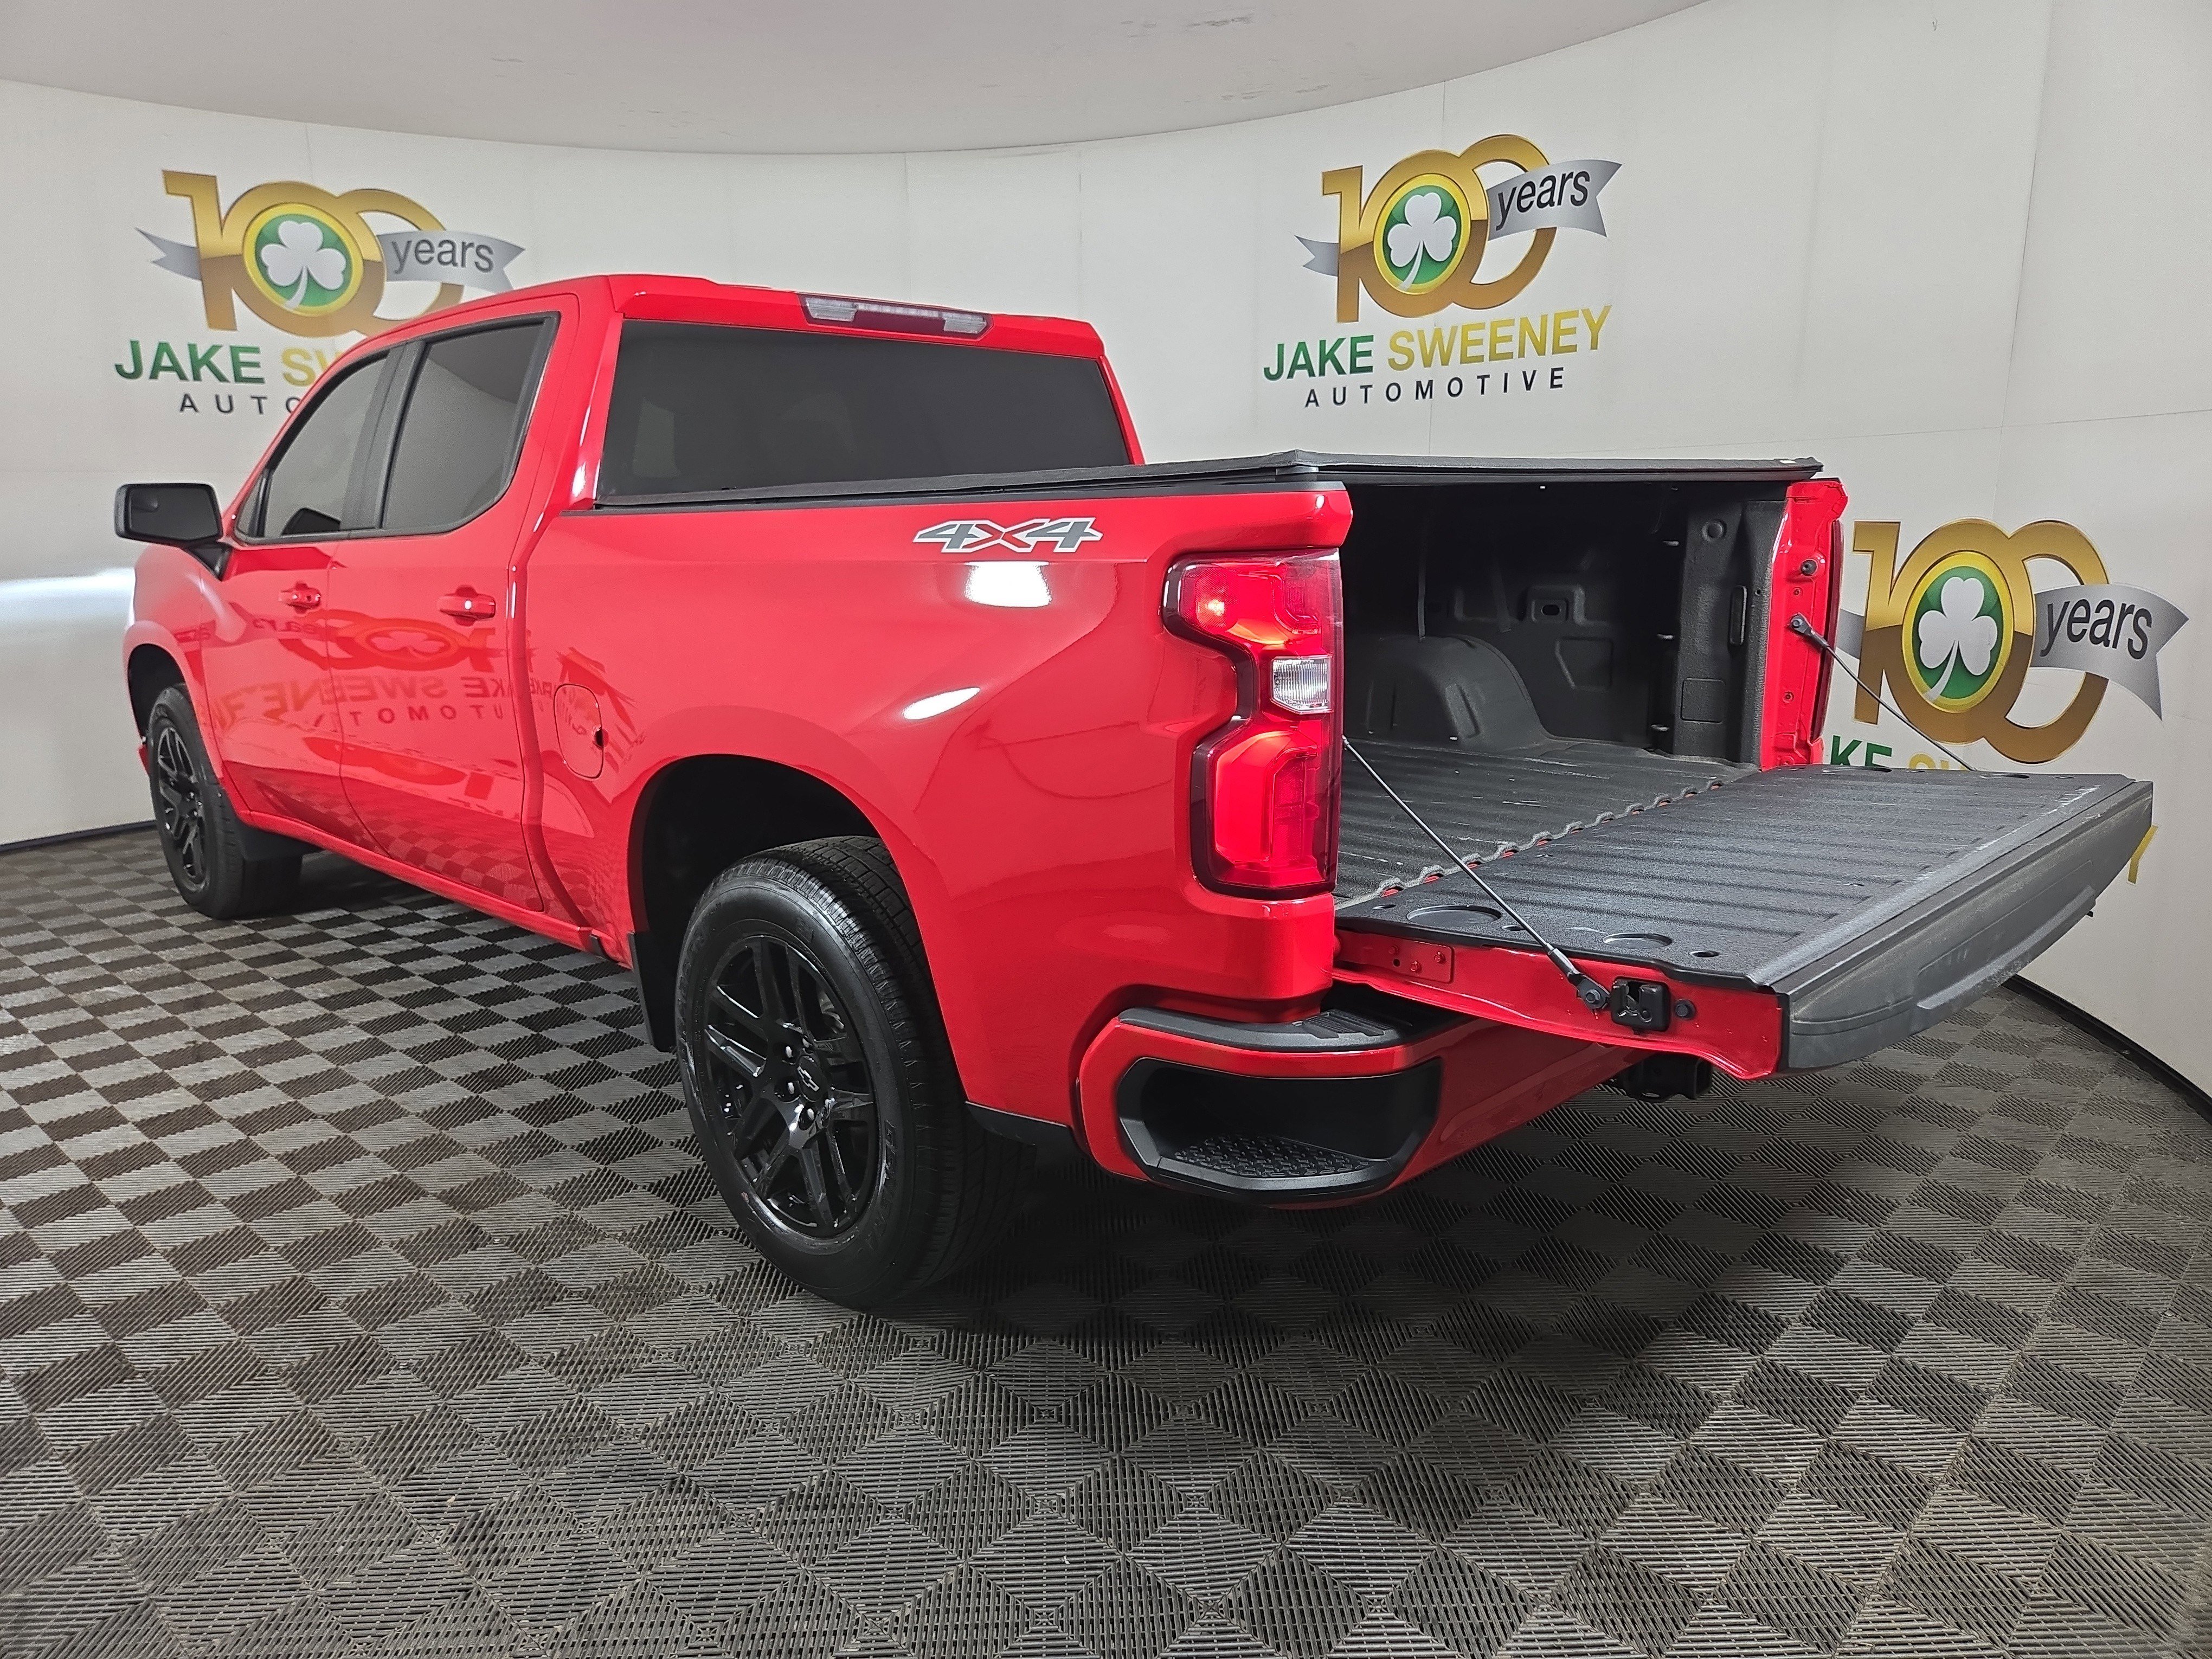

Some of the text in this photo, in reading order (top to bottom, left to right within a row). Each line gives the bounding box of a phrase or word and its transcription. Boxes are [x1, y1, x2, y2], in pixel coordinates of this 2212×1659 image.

[1495, 169, 1591, 232] years
[391, 238, 495, 274] years
[114, 339, 266, 384] JAKE
[1263, 305, 1612, 382] JAKE SWEENEY
[179, 393, 301, 415] AUTO
[1304, 366, 1565, 408] AUTOMOTIVE
[2040, 598, 2152, 660] years
